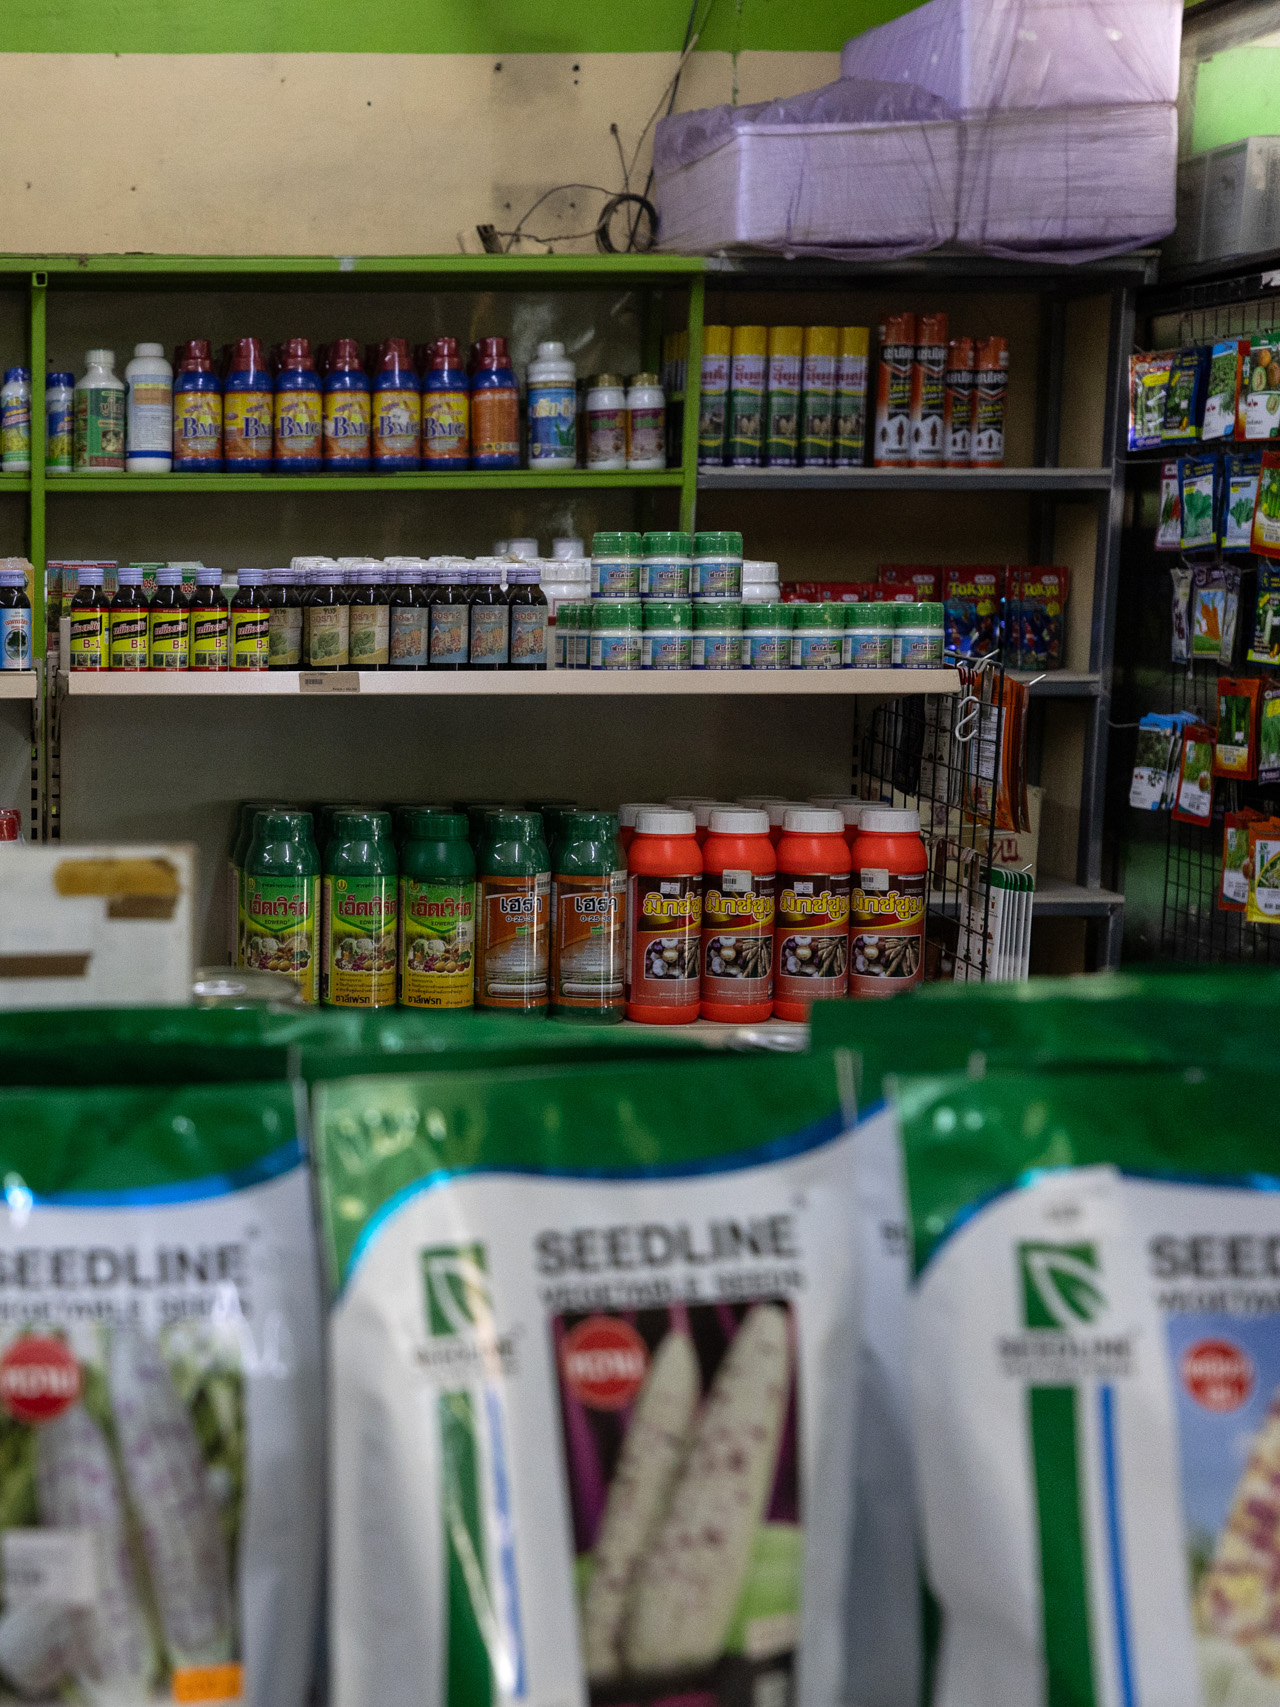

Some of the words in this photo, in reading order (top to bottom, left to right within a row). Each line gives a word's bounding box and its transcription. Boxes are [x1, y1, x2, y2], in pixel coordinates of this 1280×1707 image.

[949, 582, 995, 597] Tokyu
[1024, 582, 1059, 597] Tokyu
[83, 639, 101, 649] B-1
[131, 639, 147, 649] B-1
[172, 639, 188, 649] B-1
[500, 892, 542, 913] เฮร่า
[575, 892, 618, 914] เฮร่า
[643, 892, 702, 921] มิกซ์ซู
[534, 1212, 799, 1277] SEEDLINE
